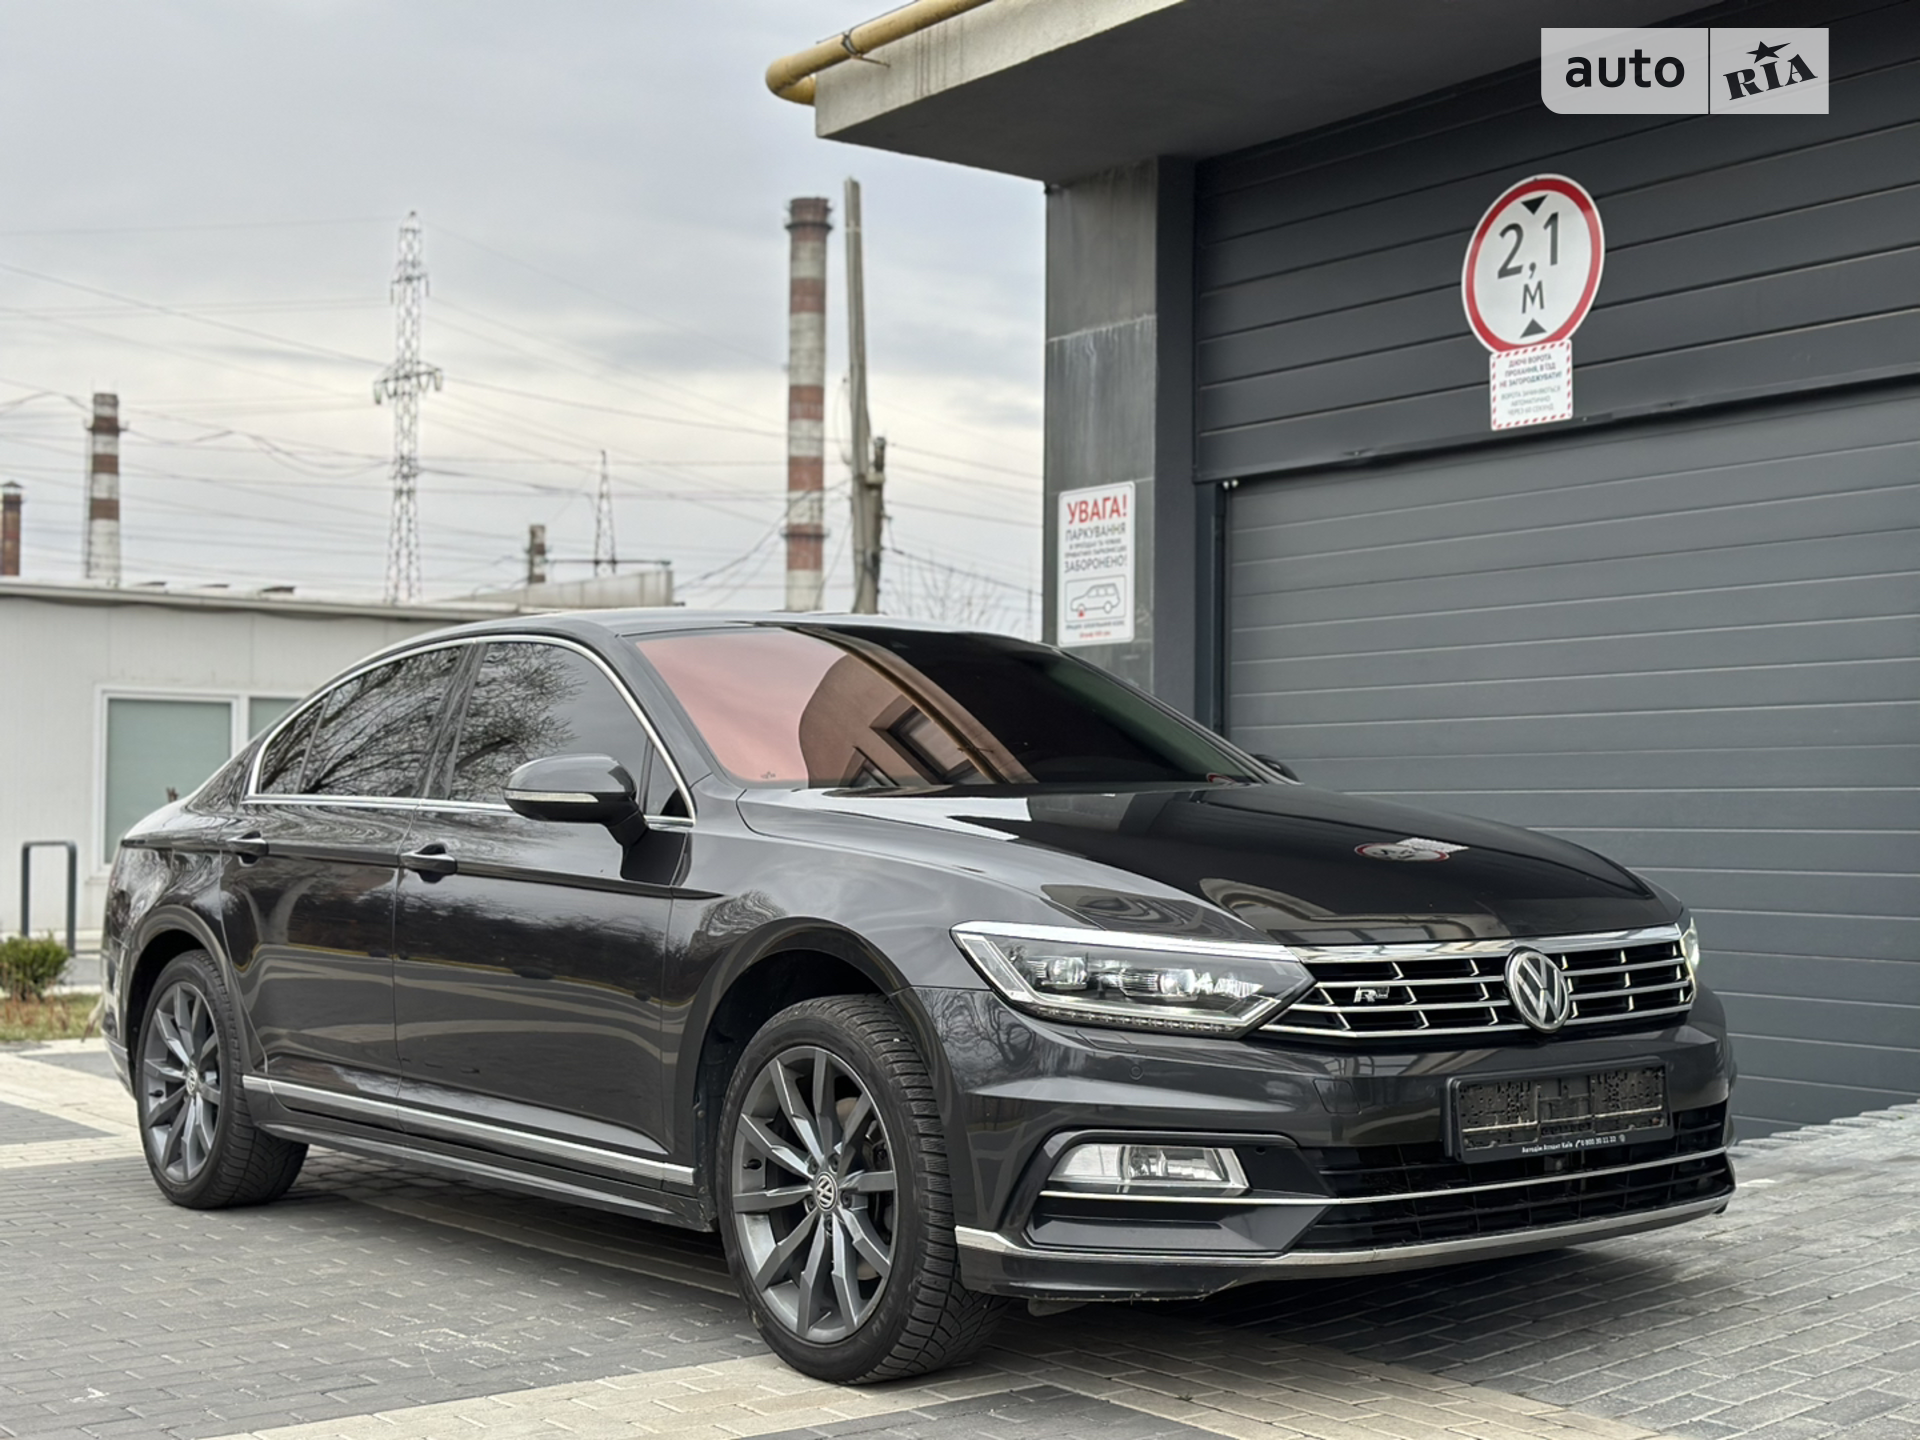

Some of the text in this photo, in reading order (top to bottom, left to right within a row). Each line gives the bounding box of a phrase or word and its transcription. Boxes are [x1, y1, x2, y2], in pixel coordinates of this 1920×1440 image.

[1497, 211, 1559, 280] 2,1
[1067, 494, 1127, 525] УВАГА!
[1065, 522, 1126, 542] ПАРКУВАННЯ
